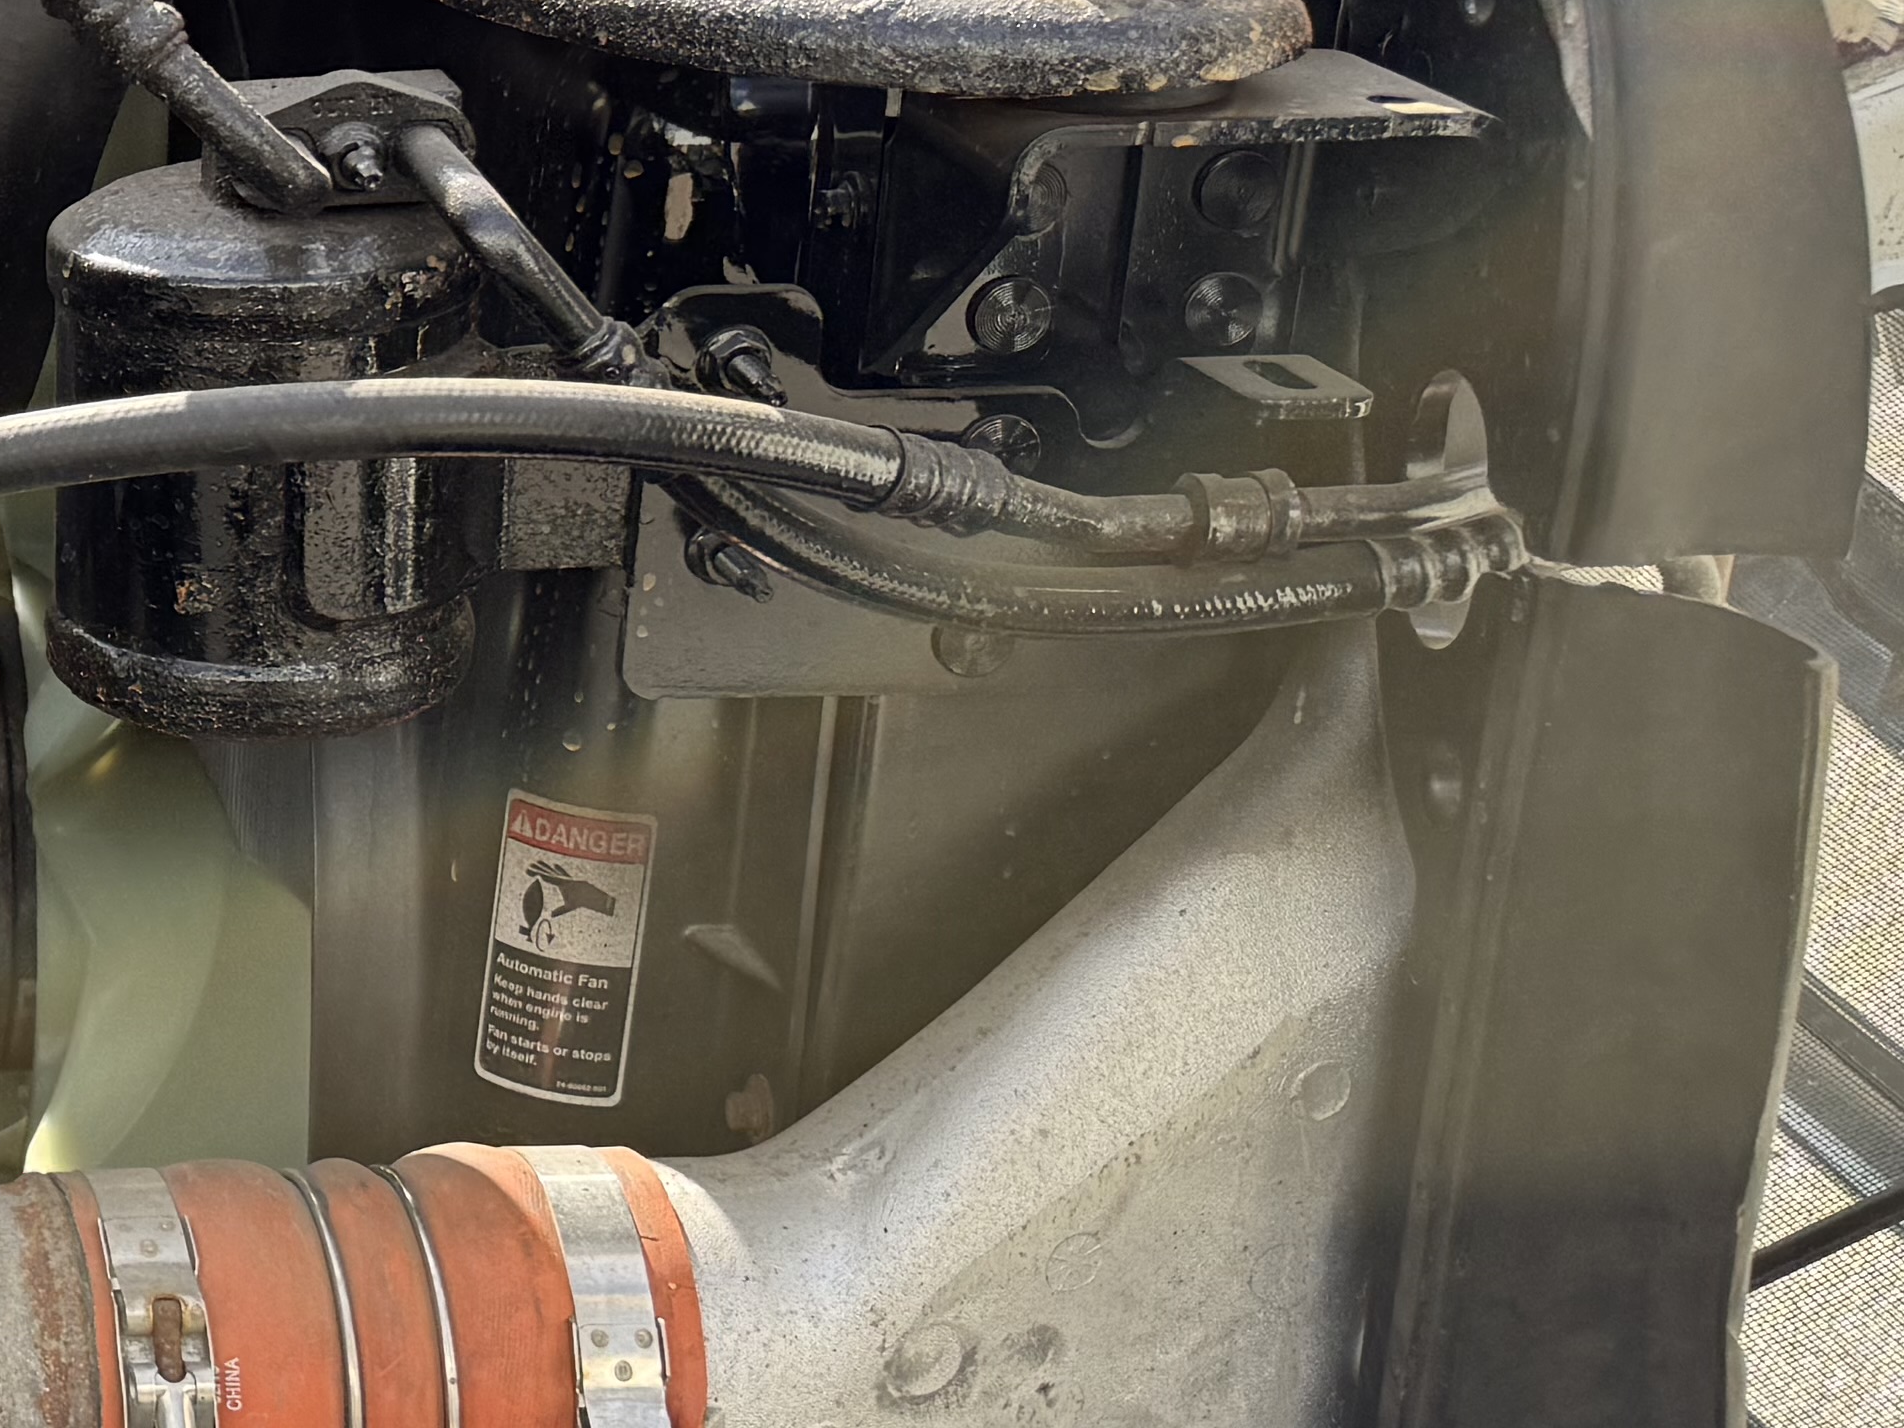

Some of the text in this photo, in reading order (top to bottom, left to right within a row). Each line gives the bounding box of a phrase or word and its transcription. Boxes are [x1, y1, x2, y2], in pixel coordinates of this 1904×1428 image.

[533, 817, 647, 856] DANGER
[496, 952, 609, 989] Automatic Fan
[492, 991, 589, 1024] when engine is
[494, 973, 609, 1010] Keep hands clear
[490, 1005, 540, 1032] running.
[486, 1039, 537, 1066] by itself.
[488, 1023, 612, 1062] Fan starts or stops
[224, 1357, 243, 1411] CHINA
